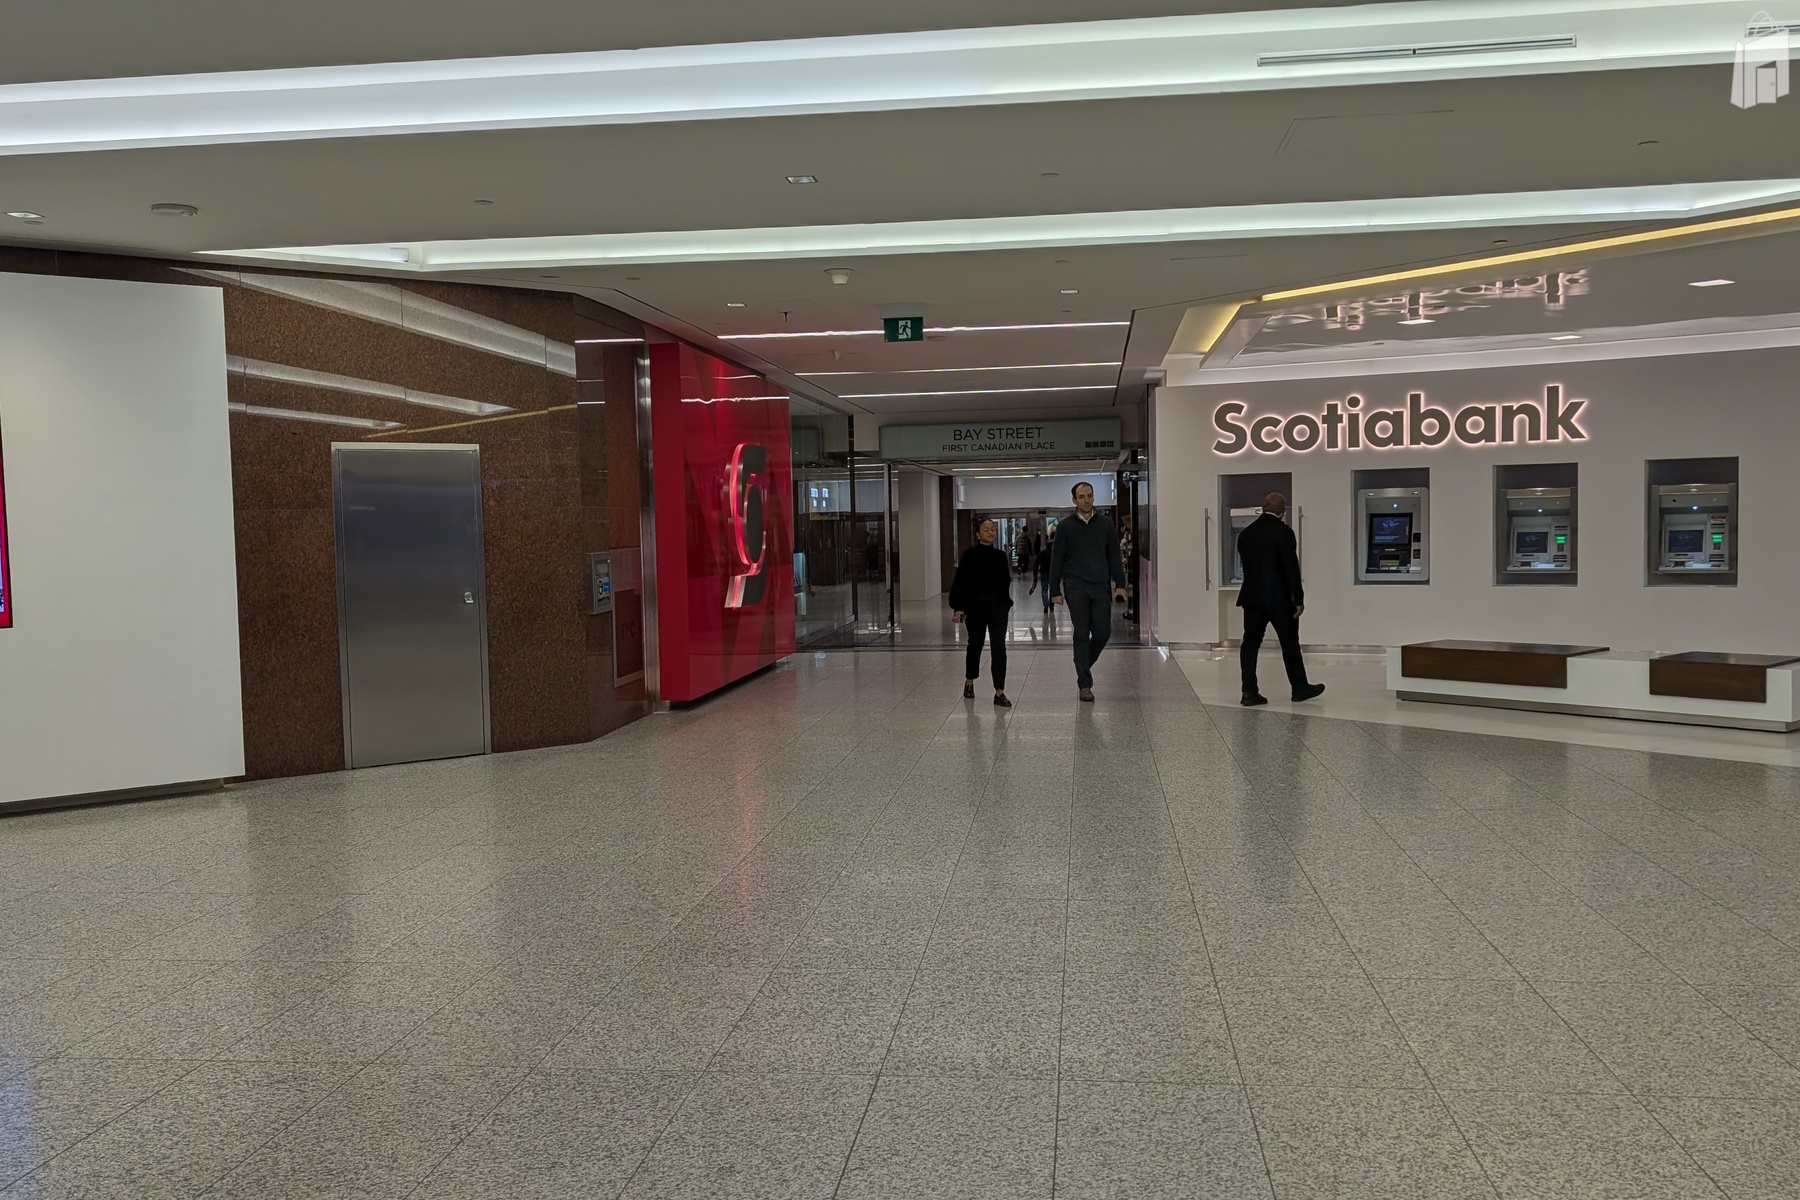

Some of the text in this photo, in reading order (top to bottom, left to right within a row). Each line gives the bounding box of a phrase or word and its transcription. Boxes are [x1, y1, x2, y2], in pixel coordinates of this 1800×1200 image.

[1213, 385, 1588, 454] Scotiabank
[953, 427, 1044, 441] BAY STREET
[942, 441, 1056, 453] FIRST CANADIAN PLACE
